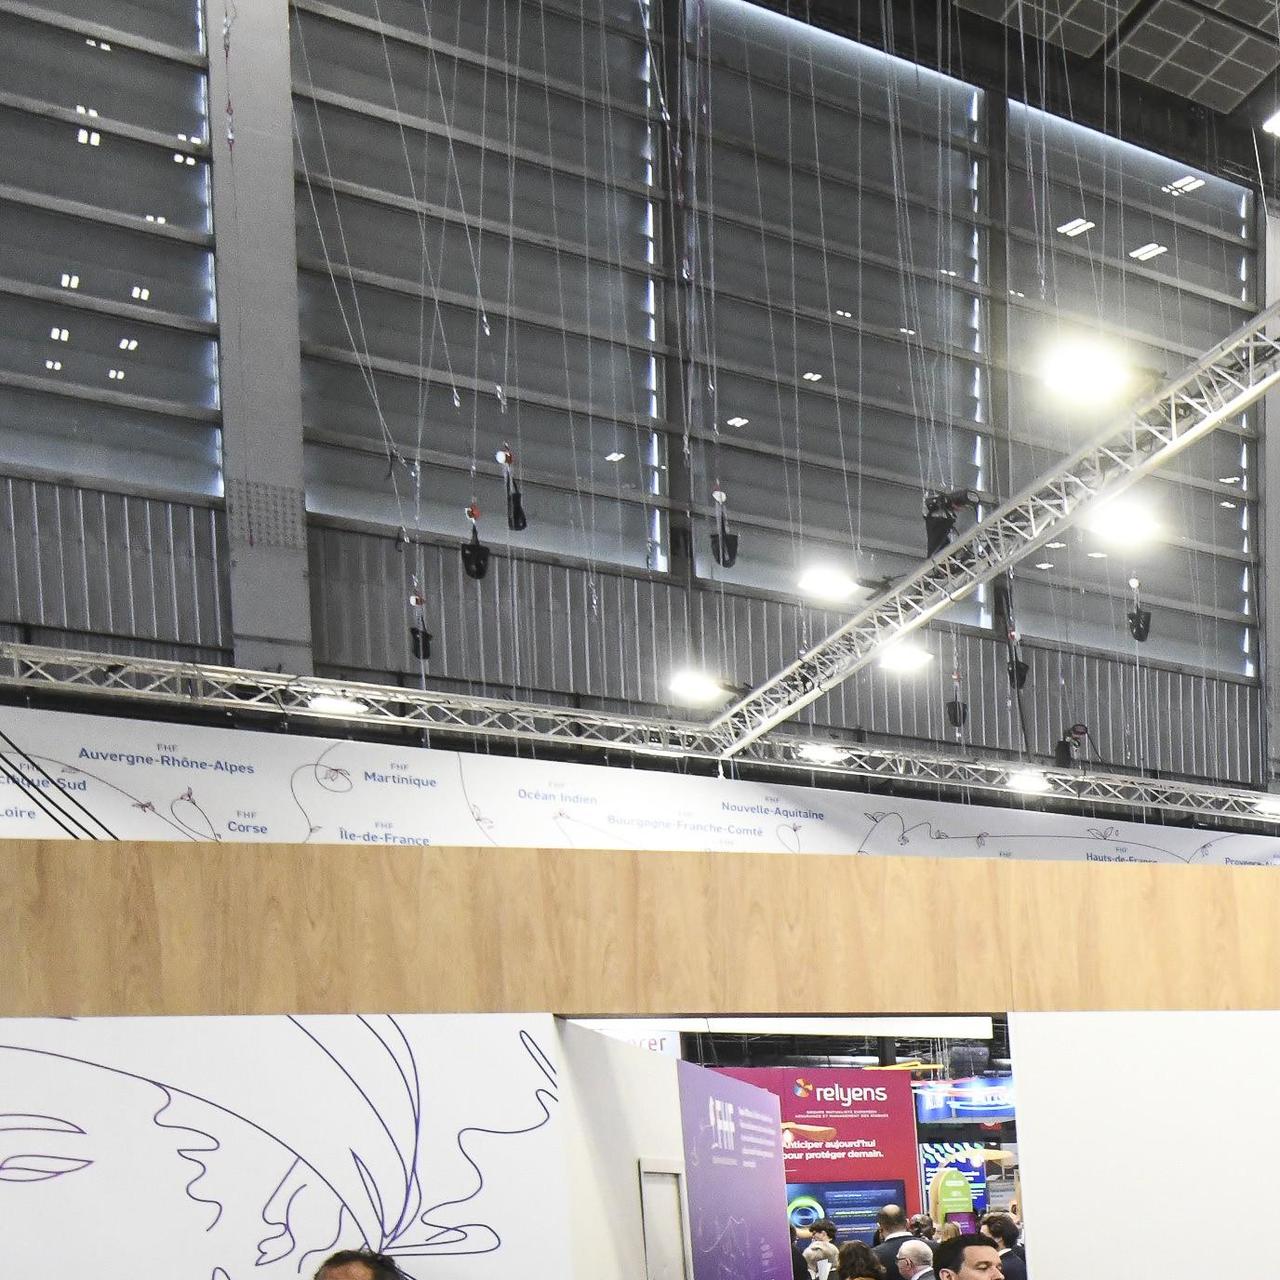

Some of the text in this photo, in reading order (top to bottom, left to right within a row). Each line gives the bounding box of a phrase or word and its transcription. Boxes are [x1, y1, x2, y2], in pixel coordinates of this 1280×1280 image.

[157, 743, 179, 753] FHF
[78, 747, 255, 774] Auvergne-Rhône-Alpes
[57, 777, 88, 792] Sud
[364, 770, 438, 789] Martinique
[517, 788, 597, 805] Océan Indien
[237, 810, 258, 819] FHF
[721, 801, 825, 821] Nouvelle-Aquitaine
[227, 821, 268, 834] Corse
[606, 814, 764, 837] Bourgogne-Franche-Comté
[338, 826, 430, 847] Île-de-France
[816, 1083, 888, 1107] relyens
[825, 1139, 876, 1149] aujourd'hui
[805, 1150, 847, 1161] protéger
[848, 1149, 885, 1159] demain.
